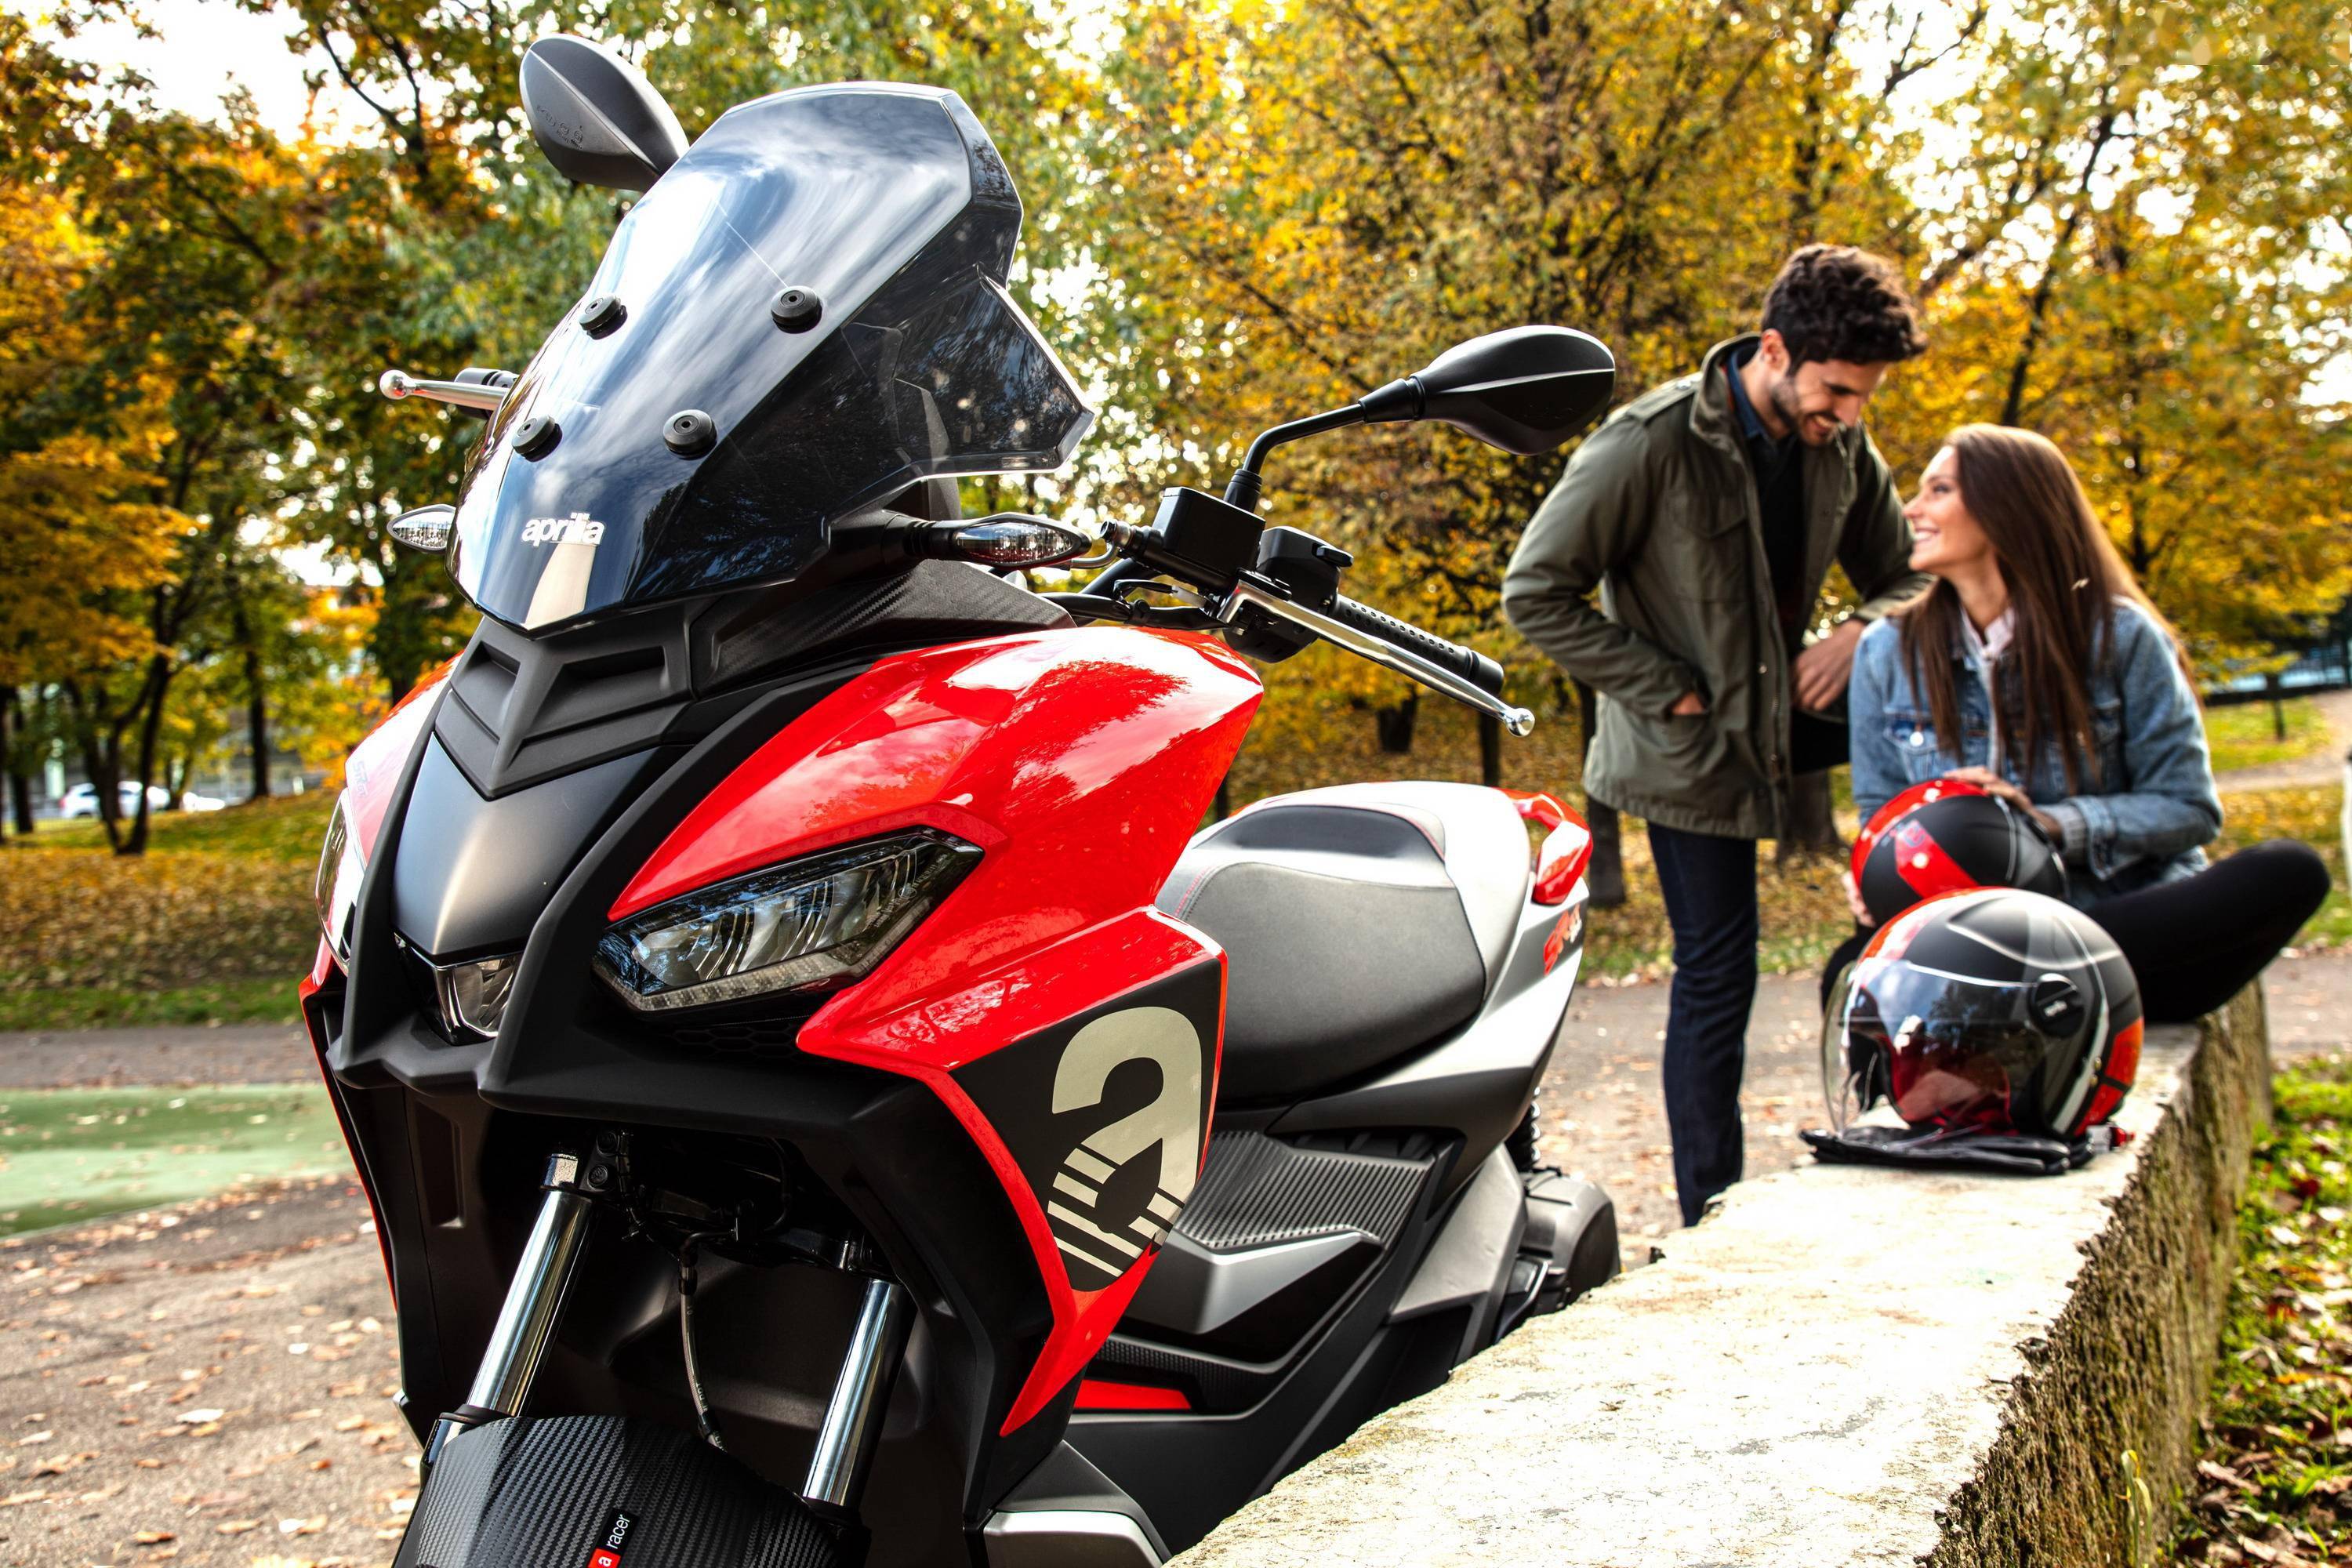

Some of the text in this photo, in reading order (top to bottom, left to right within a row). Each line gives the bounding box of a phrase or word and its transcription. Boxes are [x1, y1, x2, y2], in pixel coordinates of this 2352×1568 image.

[521, 512, 605, 546] aprilia
[598, 1514, 630, 1566] a racer
